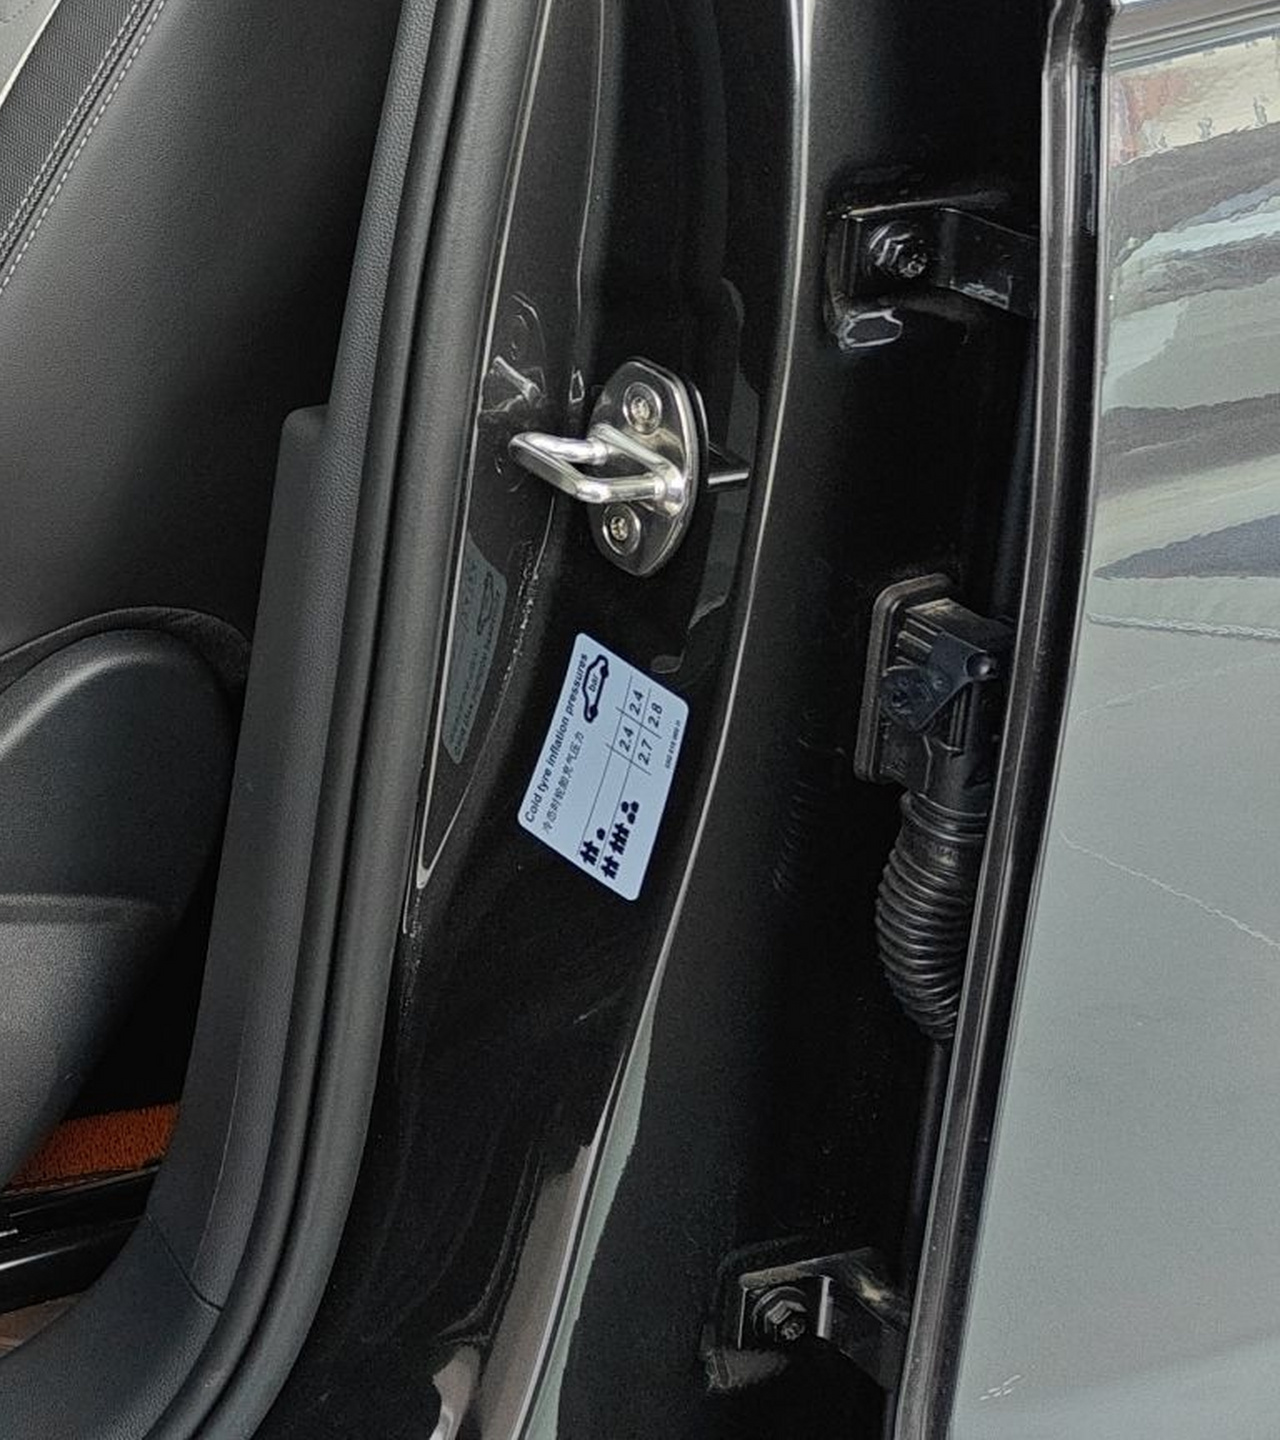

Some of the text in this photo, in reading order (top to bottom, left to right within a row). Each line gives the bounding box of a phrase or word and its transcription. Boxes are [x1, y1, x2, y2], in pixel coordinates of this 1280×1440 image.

[587, 674, 598, 693] bar
[525, 653, 589, 823] Cold tyre inflation pressures
[618, 690, 644, 752] 2.4 2.4
[638, 703, 663, 765] 2.7 2.8
